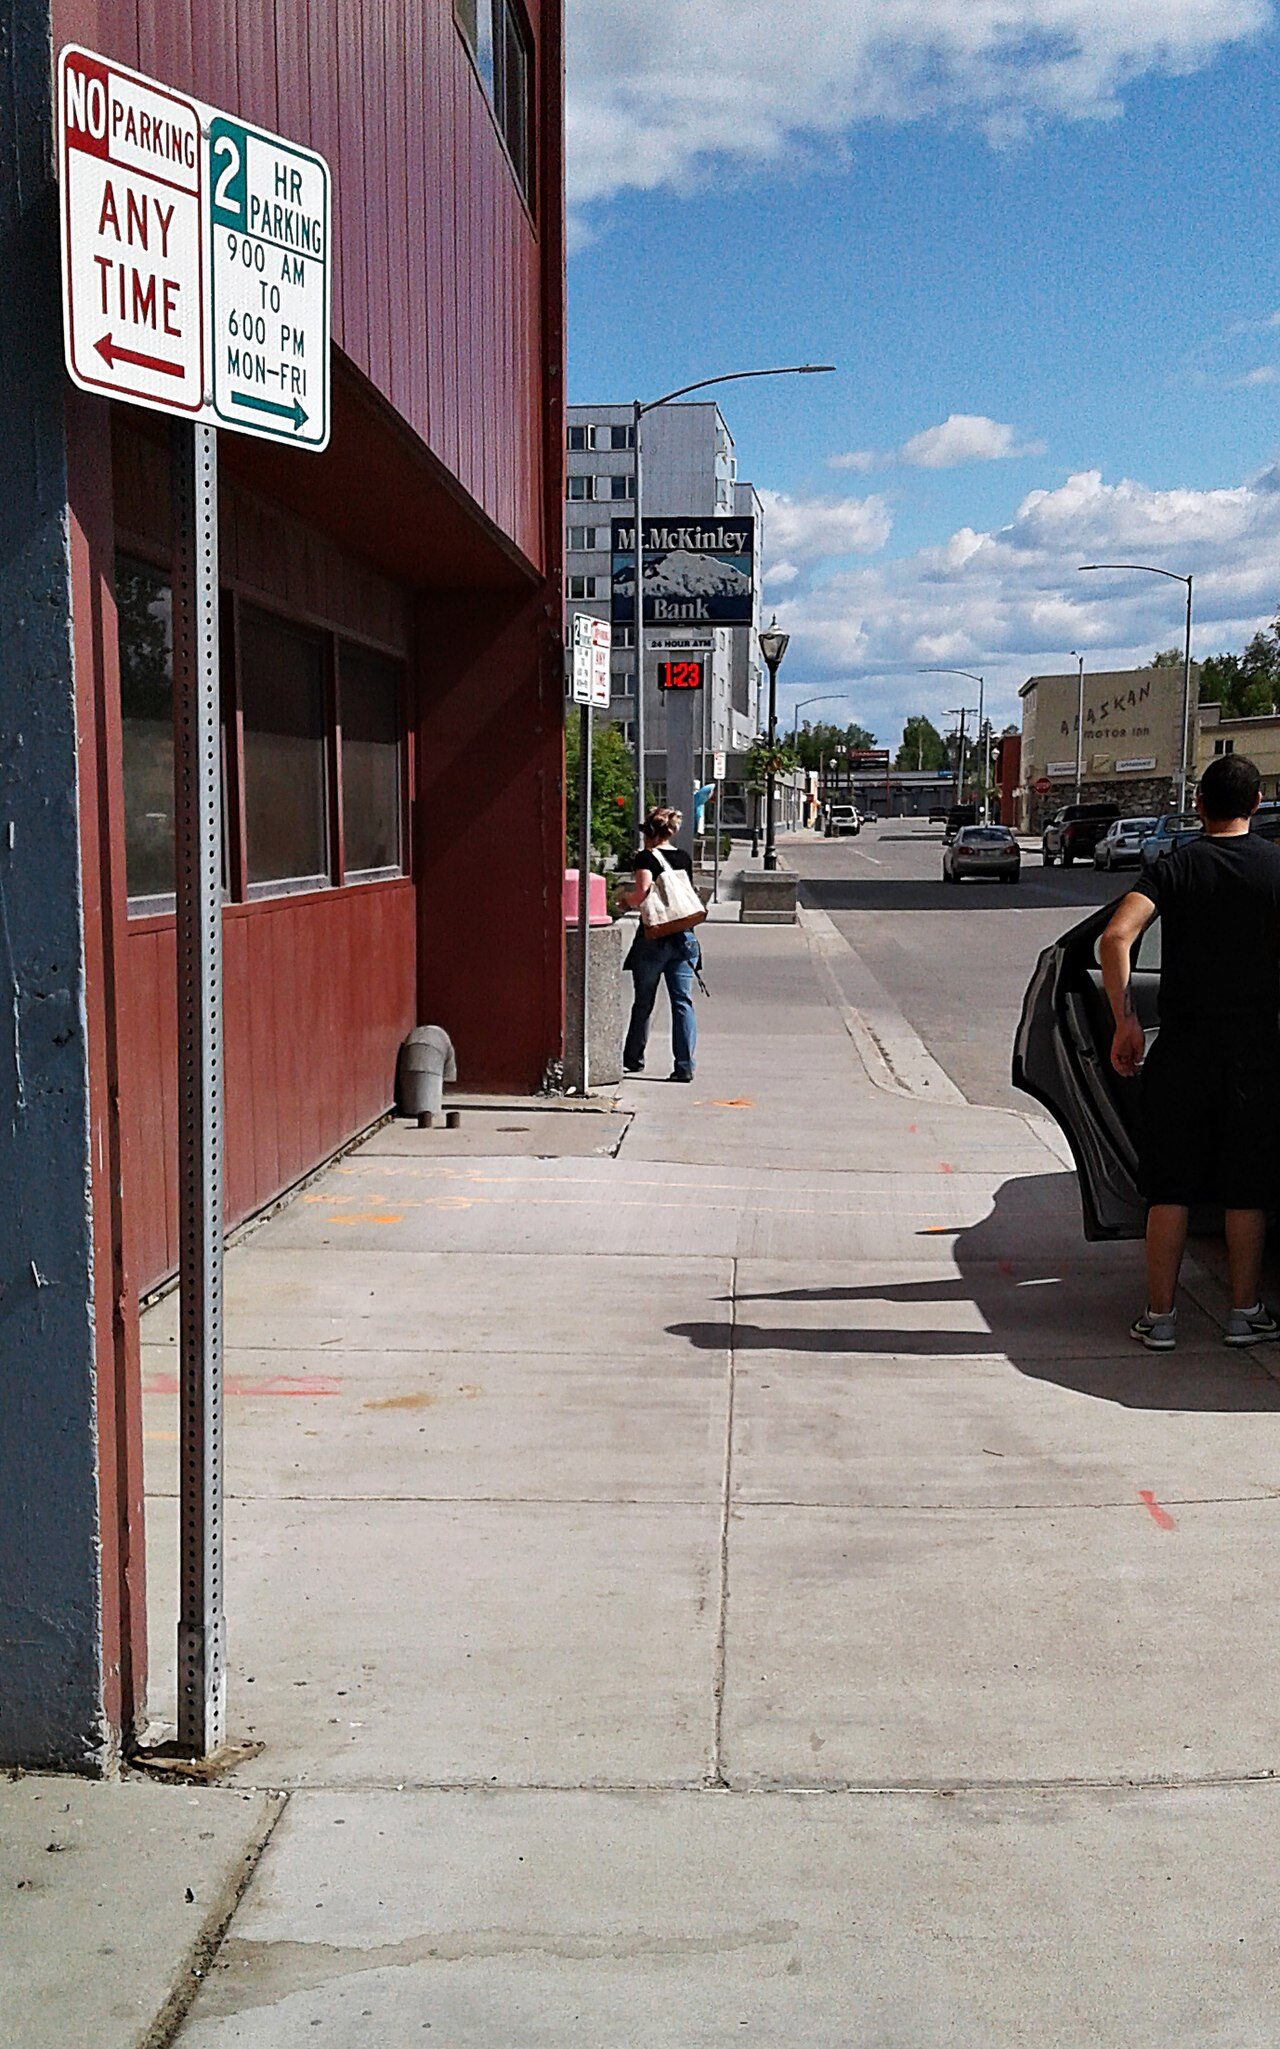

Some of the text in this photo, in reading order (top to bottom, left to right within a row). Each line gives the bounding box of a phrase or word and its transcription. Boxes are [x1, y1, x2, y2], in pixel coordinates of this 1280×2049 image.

[66, 66, 195, 169] NO PARKING
[213, 135, 242, 214] 2
[274, 161, 302, 206] HR
[98, 179, 175, 258] ANY
[250, 195, 322, 254] PARKING
[281, 253, 305, 288] AM
[93, 254, 182, 338] TIME
[259, 279, 281, 314] TO
[281, 324, 305, 358] PM
[227, 345, 307, 397] MON-FRI
[654, 597, 710, 620] Bank
[651, 640, 711, 648] 24 HOUR ATM
